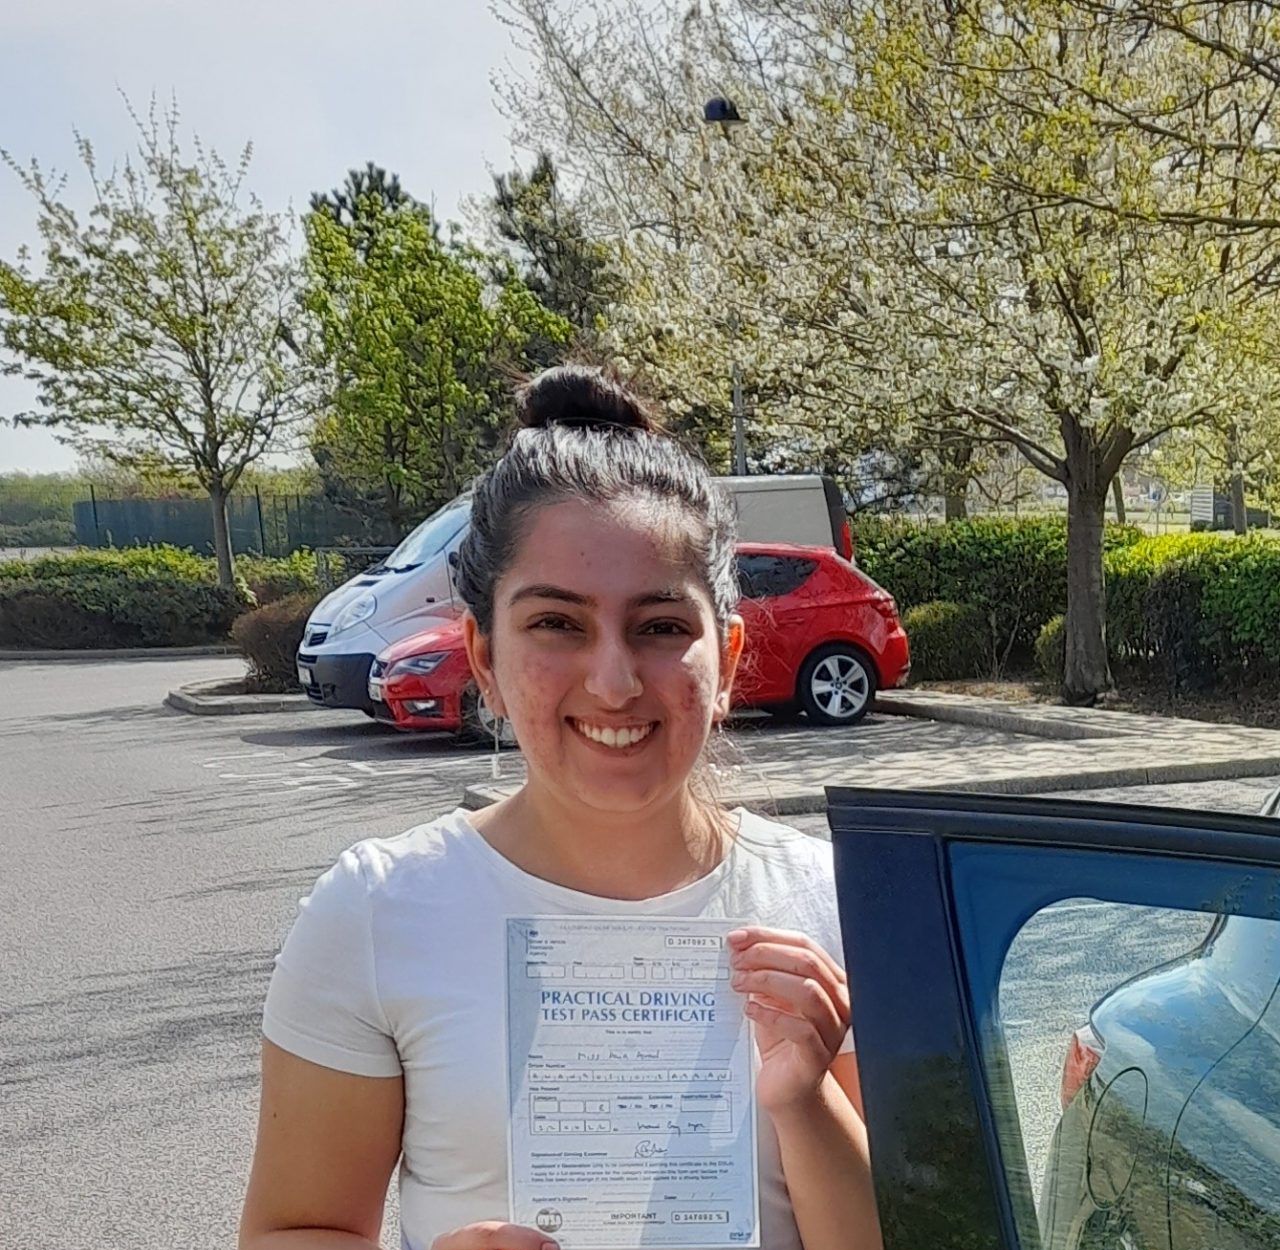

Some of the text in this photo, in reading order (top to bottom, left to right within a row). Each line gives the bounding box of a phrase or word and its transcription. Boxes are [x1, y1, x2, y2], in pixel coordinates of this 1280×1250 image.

[541, 991, 715, 1006] PRACTICAL DRIVING
[541, 1008, 716, 1022] TEST PASS CERTIFICATE
[611, 1212, 657, 1220] IMPORTANT
